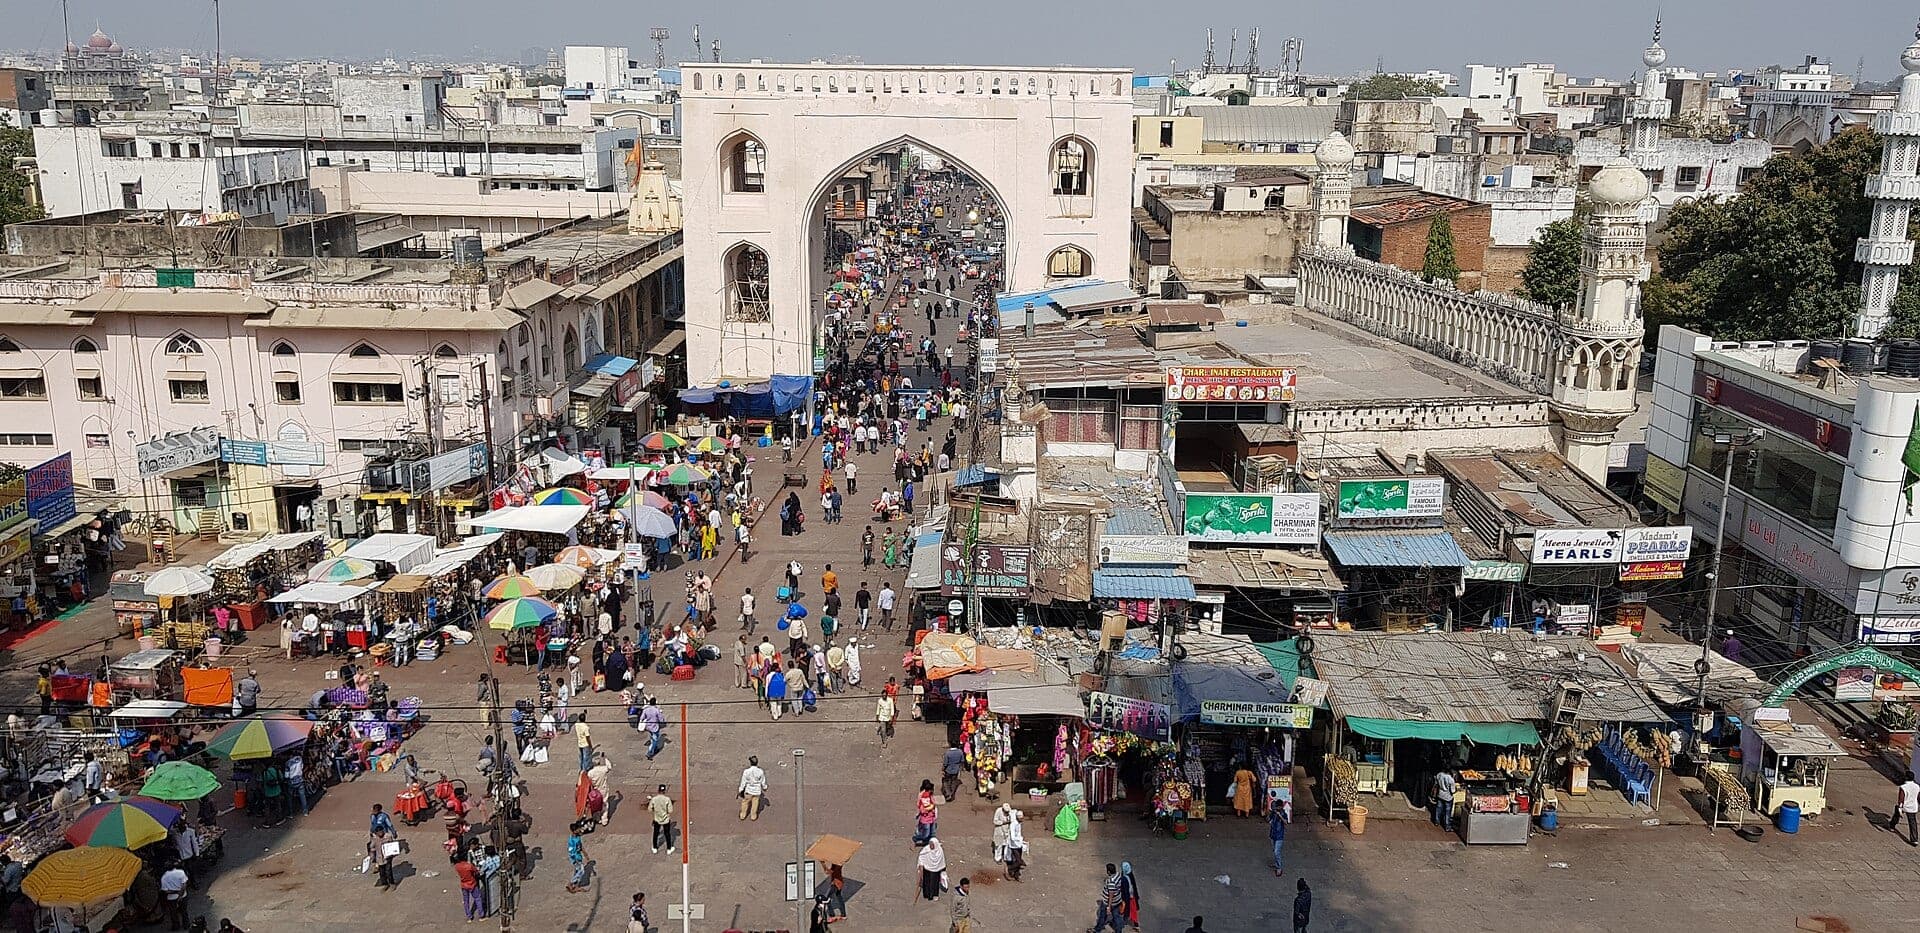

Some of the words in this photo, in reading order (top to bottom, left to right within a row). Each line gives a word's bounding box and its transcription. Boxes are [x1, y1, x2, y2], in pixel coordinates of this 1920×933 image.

[1183, 368, 1229, 377] CHARINAR
[1230, 368, 1282, 377] RESTAURANT
[28, 457, 71, 484] METRO
[28, 470, 73, 502] PEARLS
[1384, 489, 1404, 499] Sprite
[1240, 508, 1265, 521] Sprite
[1273, 519, 1316, 528] CHARMINAR
[1639, 530, 1679, 541] Madam's
[1542, 539, 1571, 547] Meena
[1573, 538, 1615, 547] Jewellers
[1627, 540, 1688, 555] PEARLS
[1543, 548, 1613, 560] PEARLS
[1630, 563, 1660, 573] Madam's
[1661, 562, 1682, 571] Pearls
[1203, 702, 1253, 713] CHARMINAR
[1255, 704, 1294, 714] BANGLES
